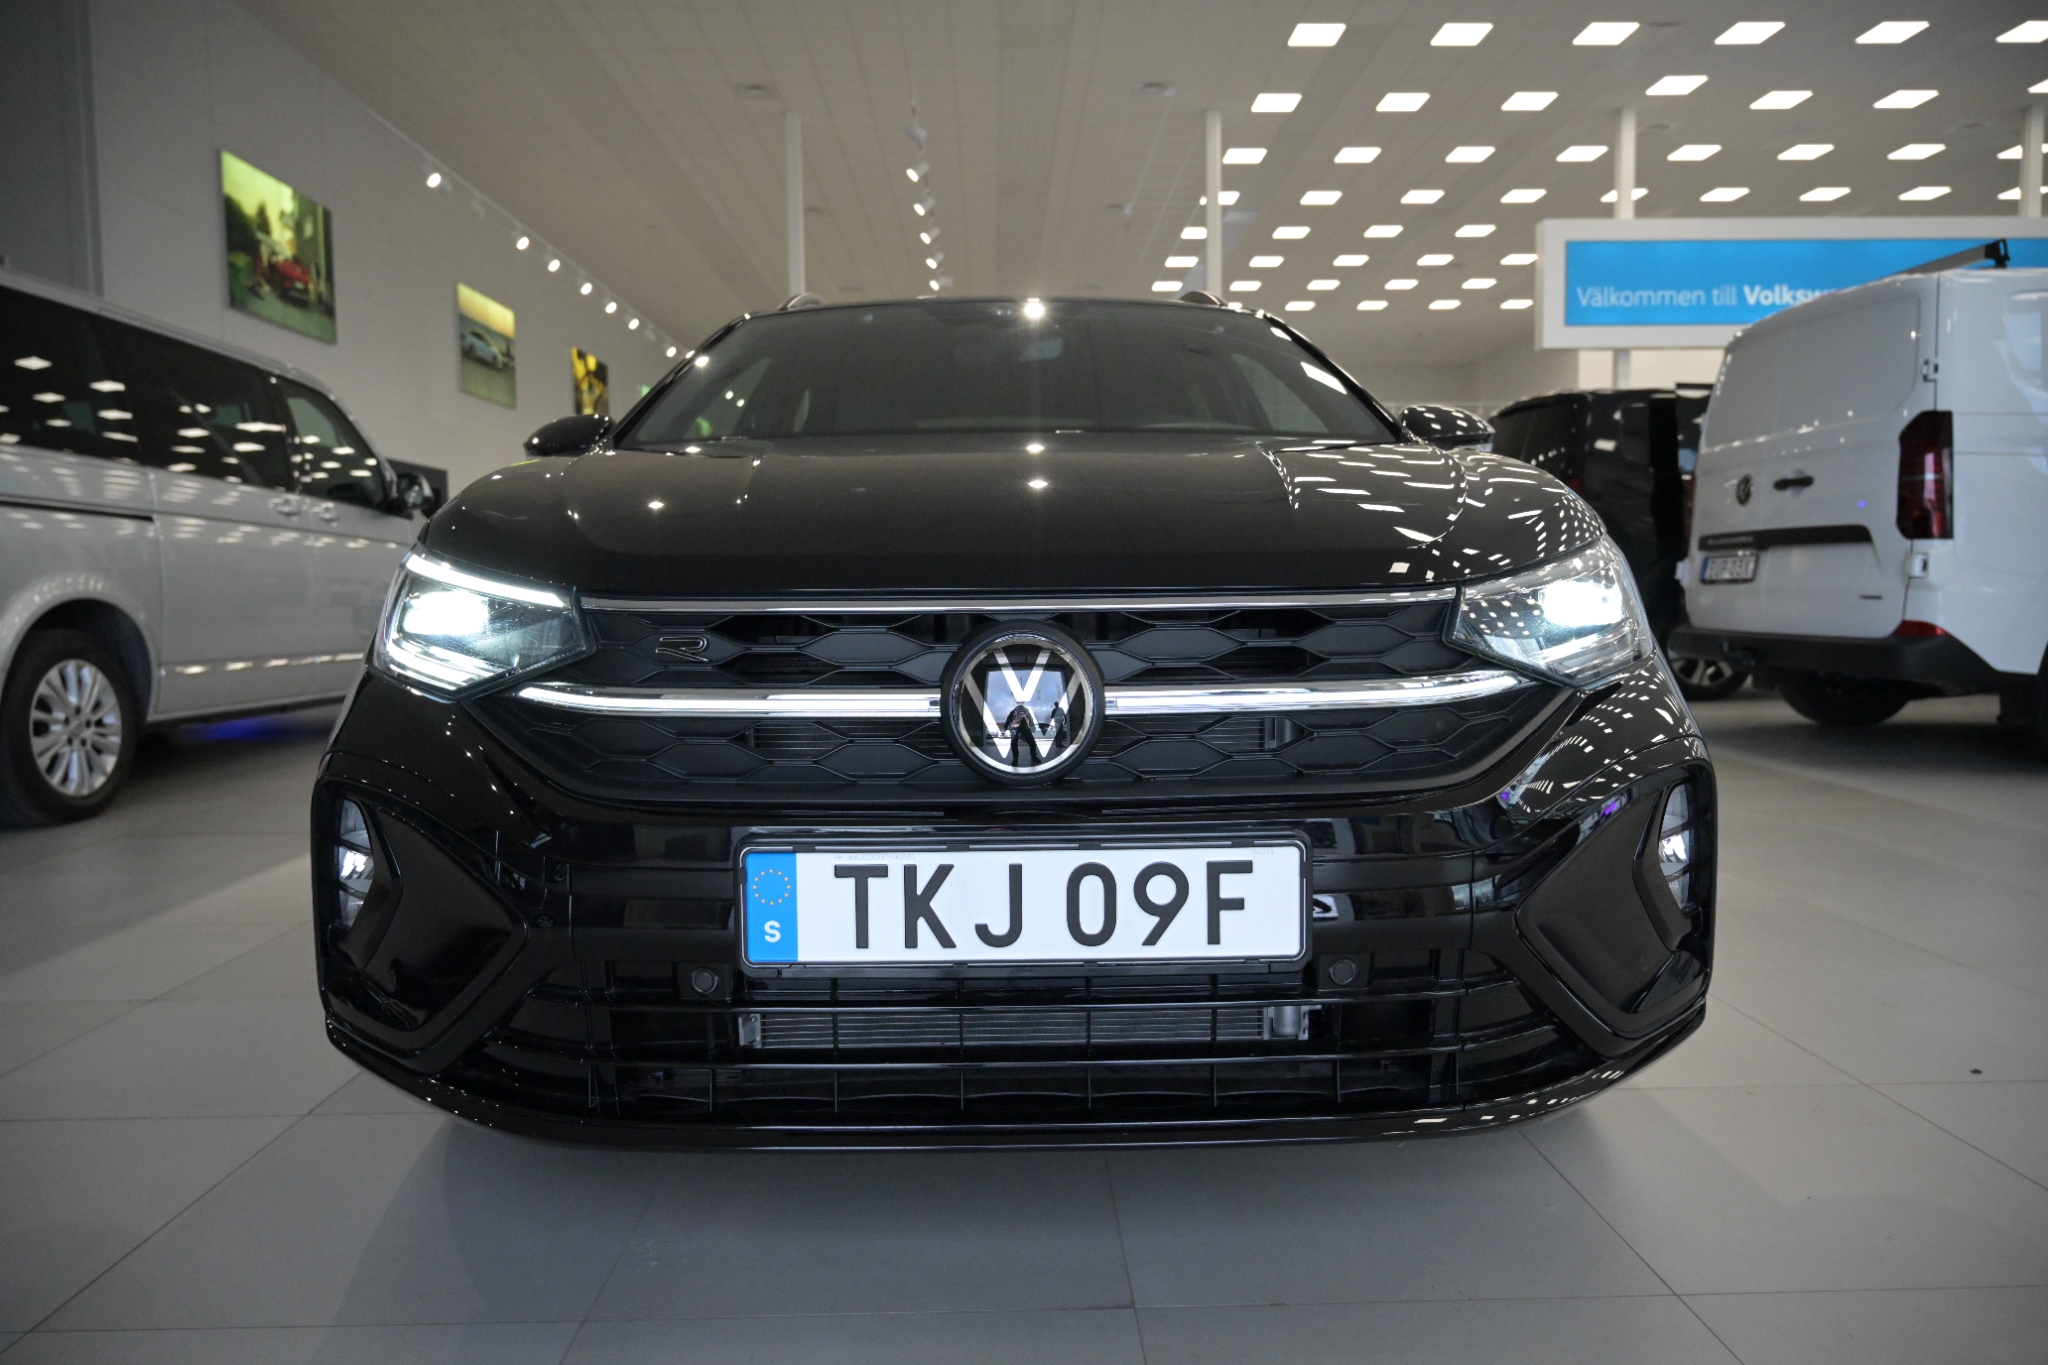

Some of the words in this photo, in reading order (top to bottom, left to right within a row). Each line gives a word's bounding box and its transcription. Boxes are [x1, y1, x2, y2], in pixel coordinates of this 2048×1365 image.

[1576, 285, 1704, 307] Välkommen
[1712, 286, 1738, 307] till
[834, 863, 1023, 949] TKJ
[1066, 860, 1254, 947] 09F
[763, 921, 782, 943] S
